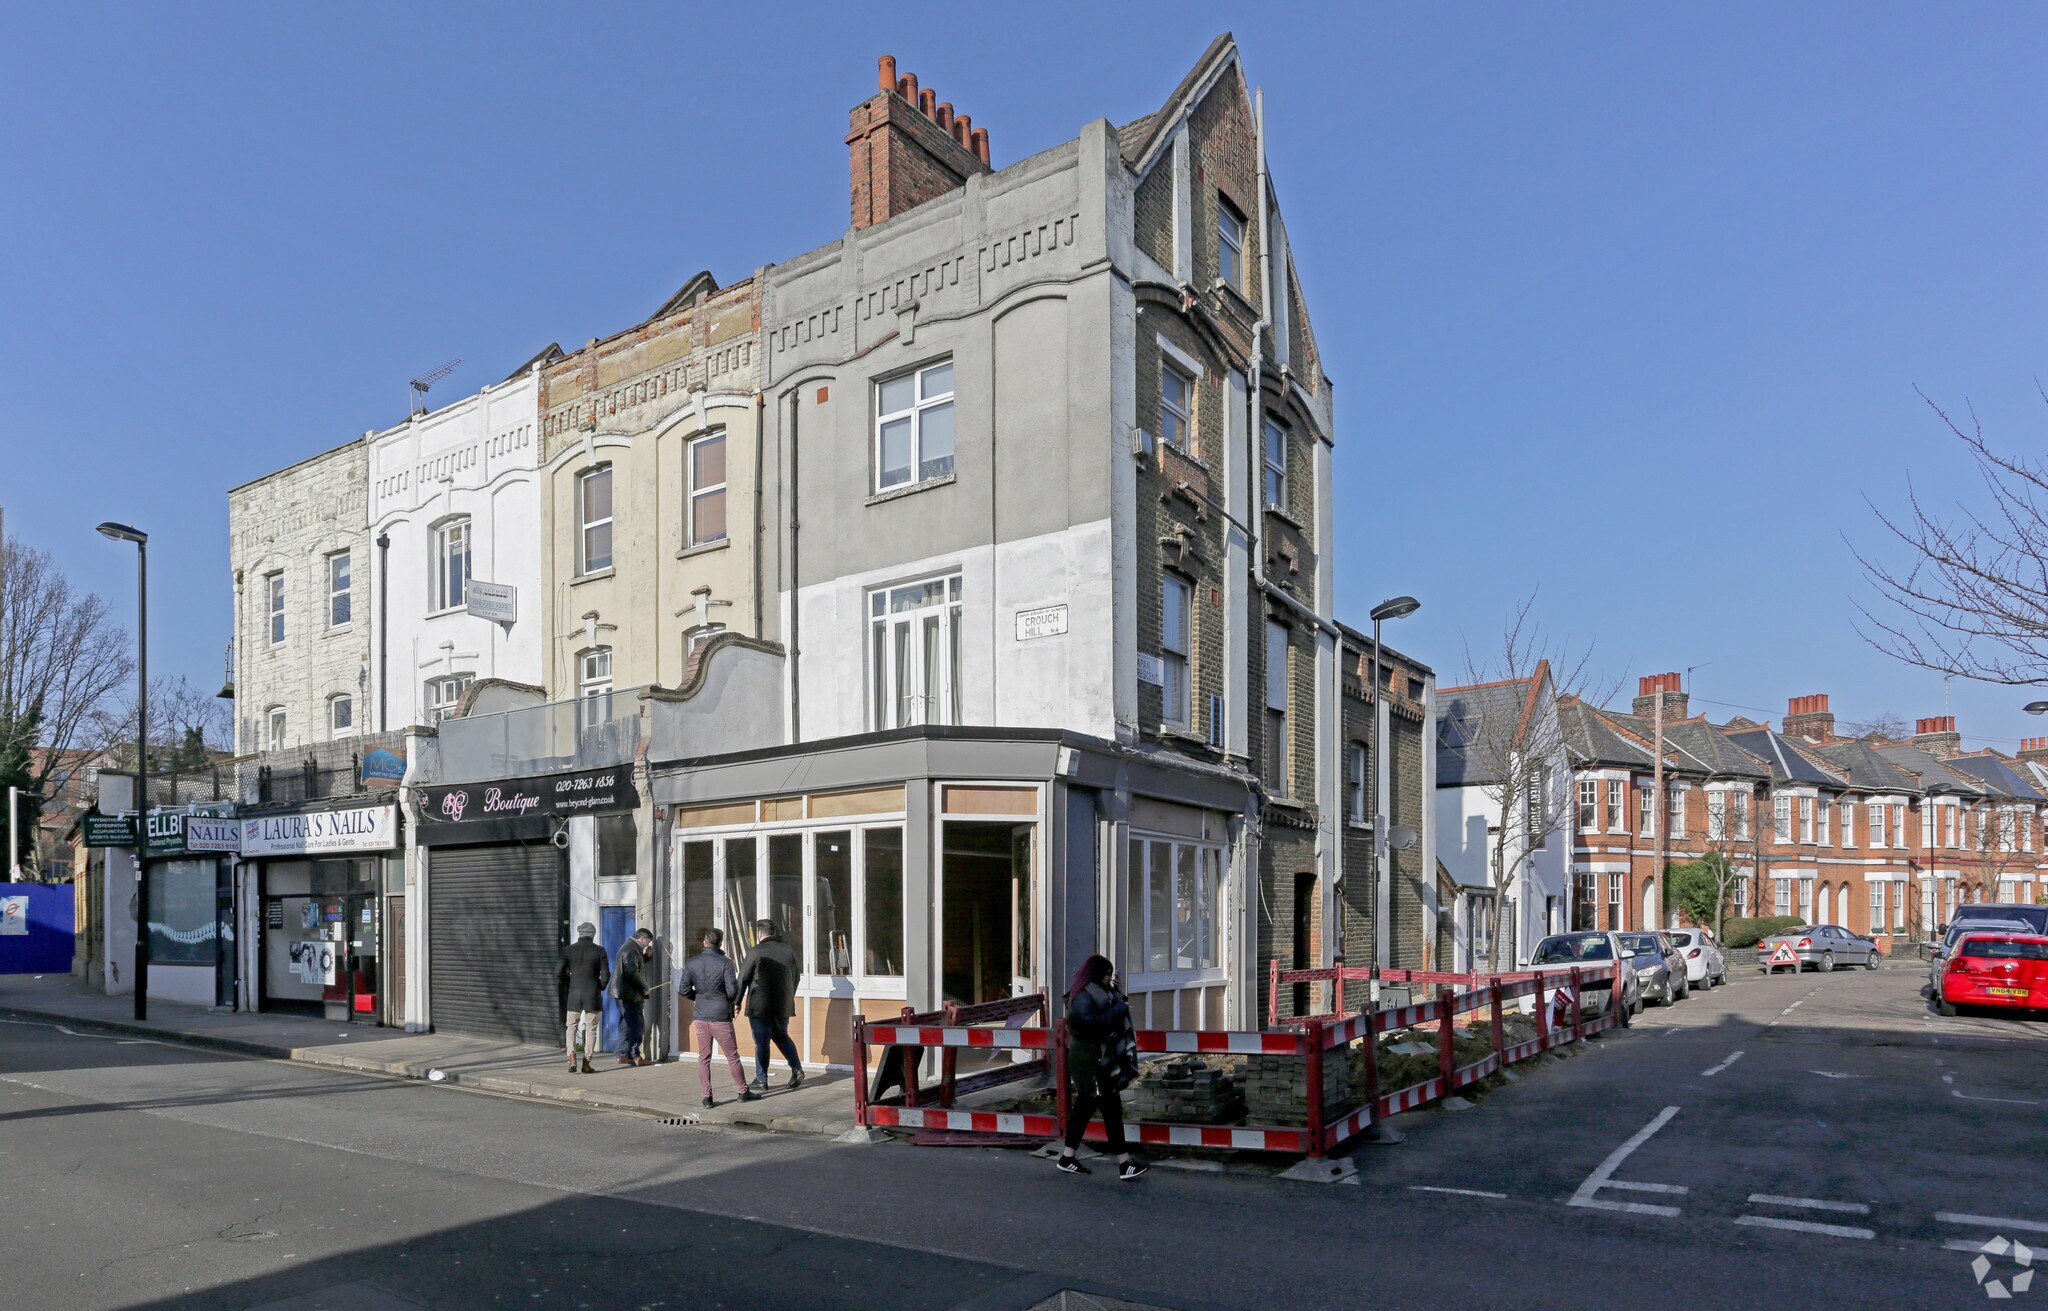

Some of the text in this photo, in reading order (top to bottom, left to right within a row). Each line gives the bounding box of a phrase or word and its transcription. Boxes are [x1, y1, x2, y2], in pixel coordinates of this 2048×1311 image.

[1025, 613, 1059, 627] CROUCH
[1025, 627, 1042, 638] HILL
[1137, 658, 1152, 671] APAN
[1137, 667, 1159, 683] RESCENT
[555, 774, 615, 792] 020-7263 1856
[483, 787, 540, 816] Boutique
[555, 794, 615, 809] www.beyond-glam.co.uk
[263, 809, 375, 841] LAURA'S NAILS
[189, 826, 239, 841] NAILS
[270, 841, 296, 850] Professional
[323, 838, 337, 848] Ladies
[342, 838, 355, 846] Gents
